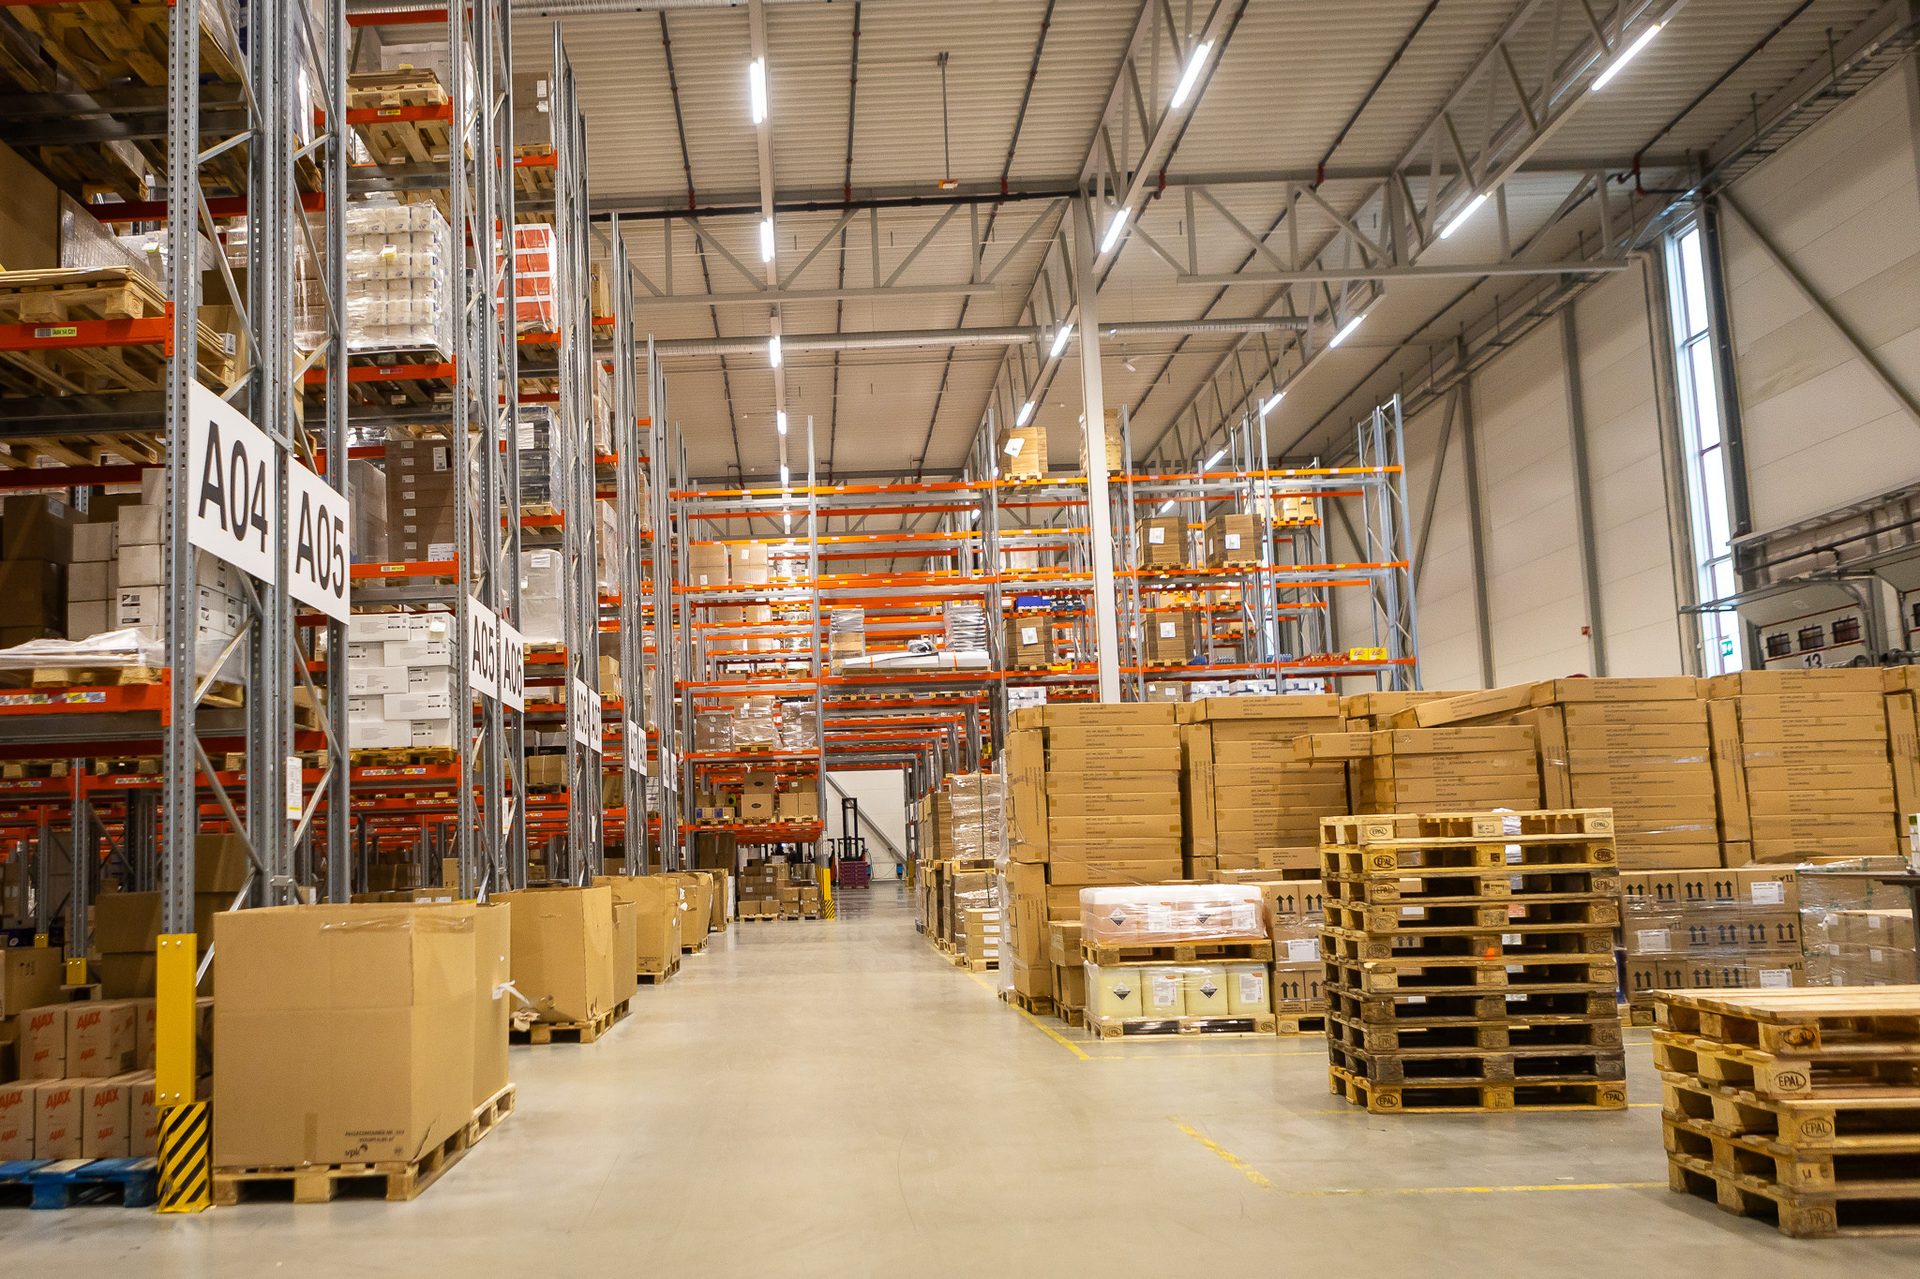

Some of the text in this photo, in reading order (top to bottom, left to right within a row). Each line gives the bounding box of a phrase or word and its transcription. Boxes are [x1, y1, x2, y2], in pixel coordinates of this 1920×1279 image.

[198, 420, 268, 553] A04
[296, 490, 345, 599] A05
[472, 614, 494, 683] A05
[503, 637, 522, 698] A06
[1805, 653, 1822, 668] 13
[29, 1012, 54, 1031] AJAX
[76, 1010, 101, 1030] AJAX
[1778, 1076, 1802, 1087] EPAL
[0, 1090, 23, 1109] AJAX
[46, 1089, 71, 1110] AJAX
[93, 1088, 119, 1108] AJAX
[1806, 1123, 1827, 1134] EPAL
